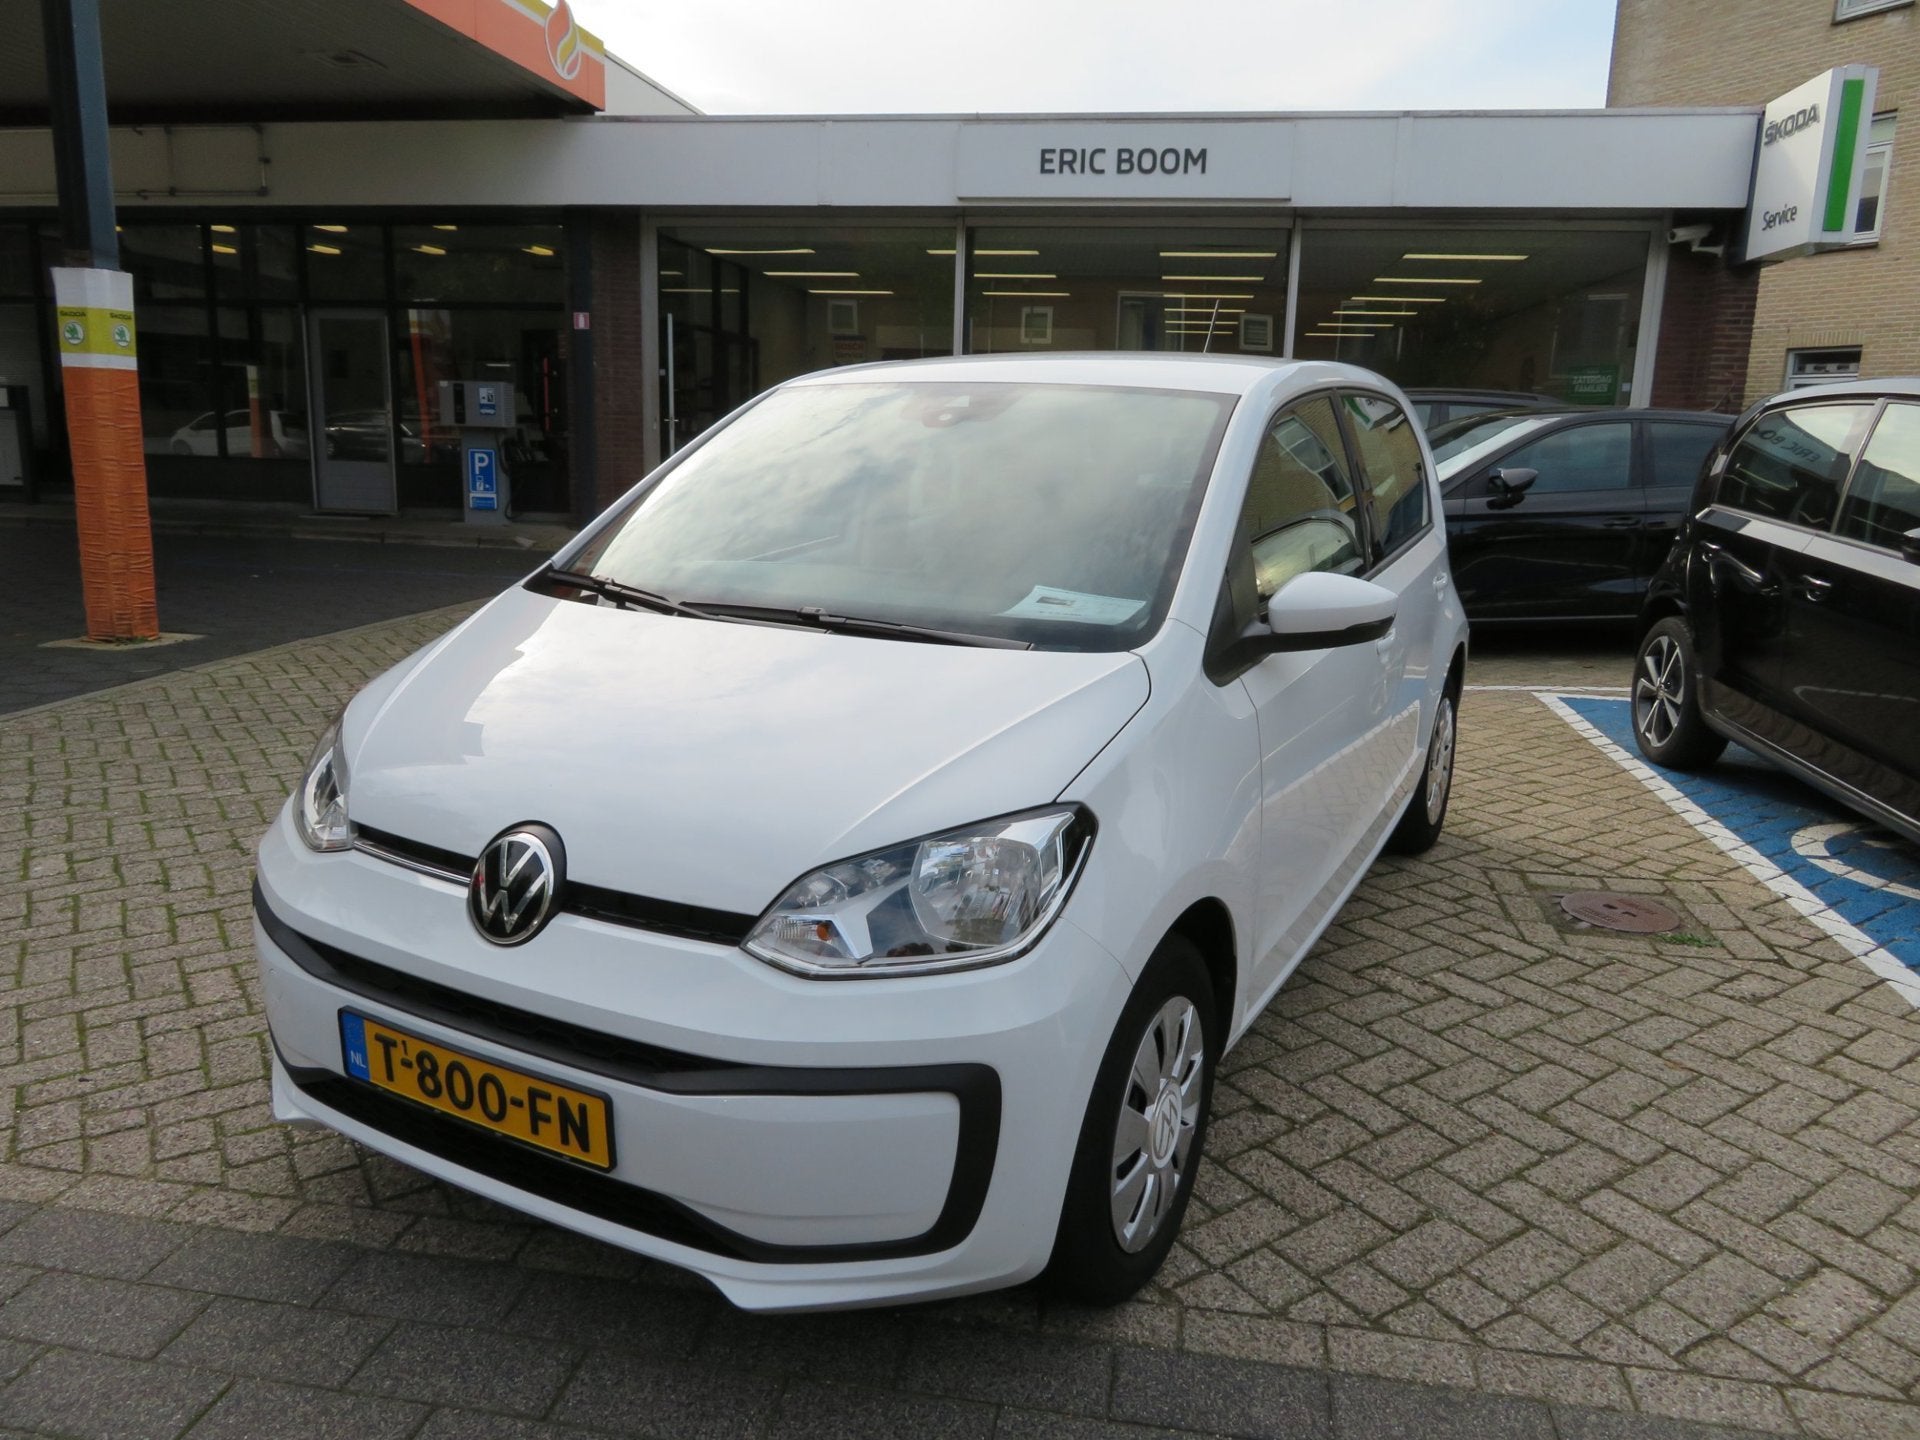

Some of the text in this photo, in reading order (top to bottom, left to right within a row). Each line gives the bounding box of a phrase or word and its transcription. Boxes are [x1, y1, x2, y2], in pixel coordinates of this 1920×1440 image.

[1040, 148, 1208, 174] ERIC BOOM
[1762, 204, 1798, 232] Service
[474, 452, 489, 475] P
[350, 1050, 367, 1069] NL
